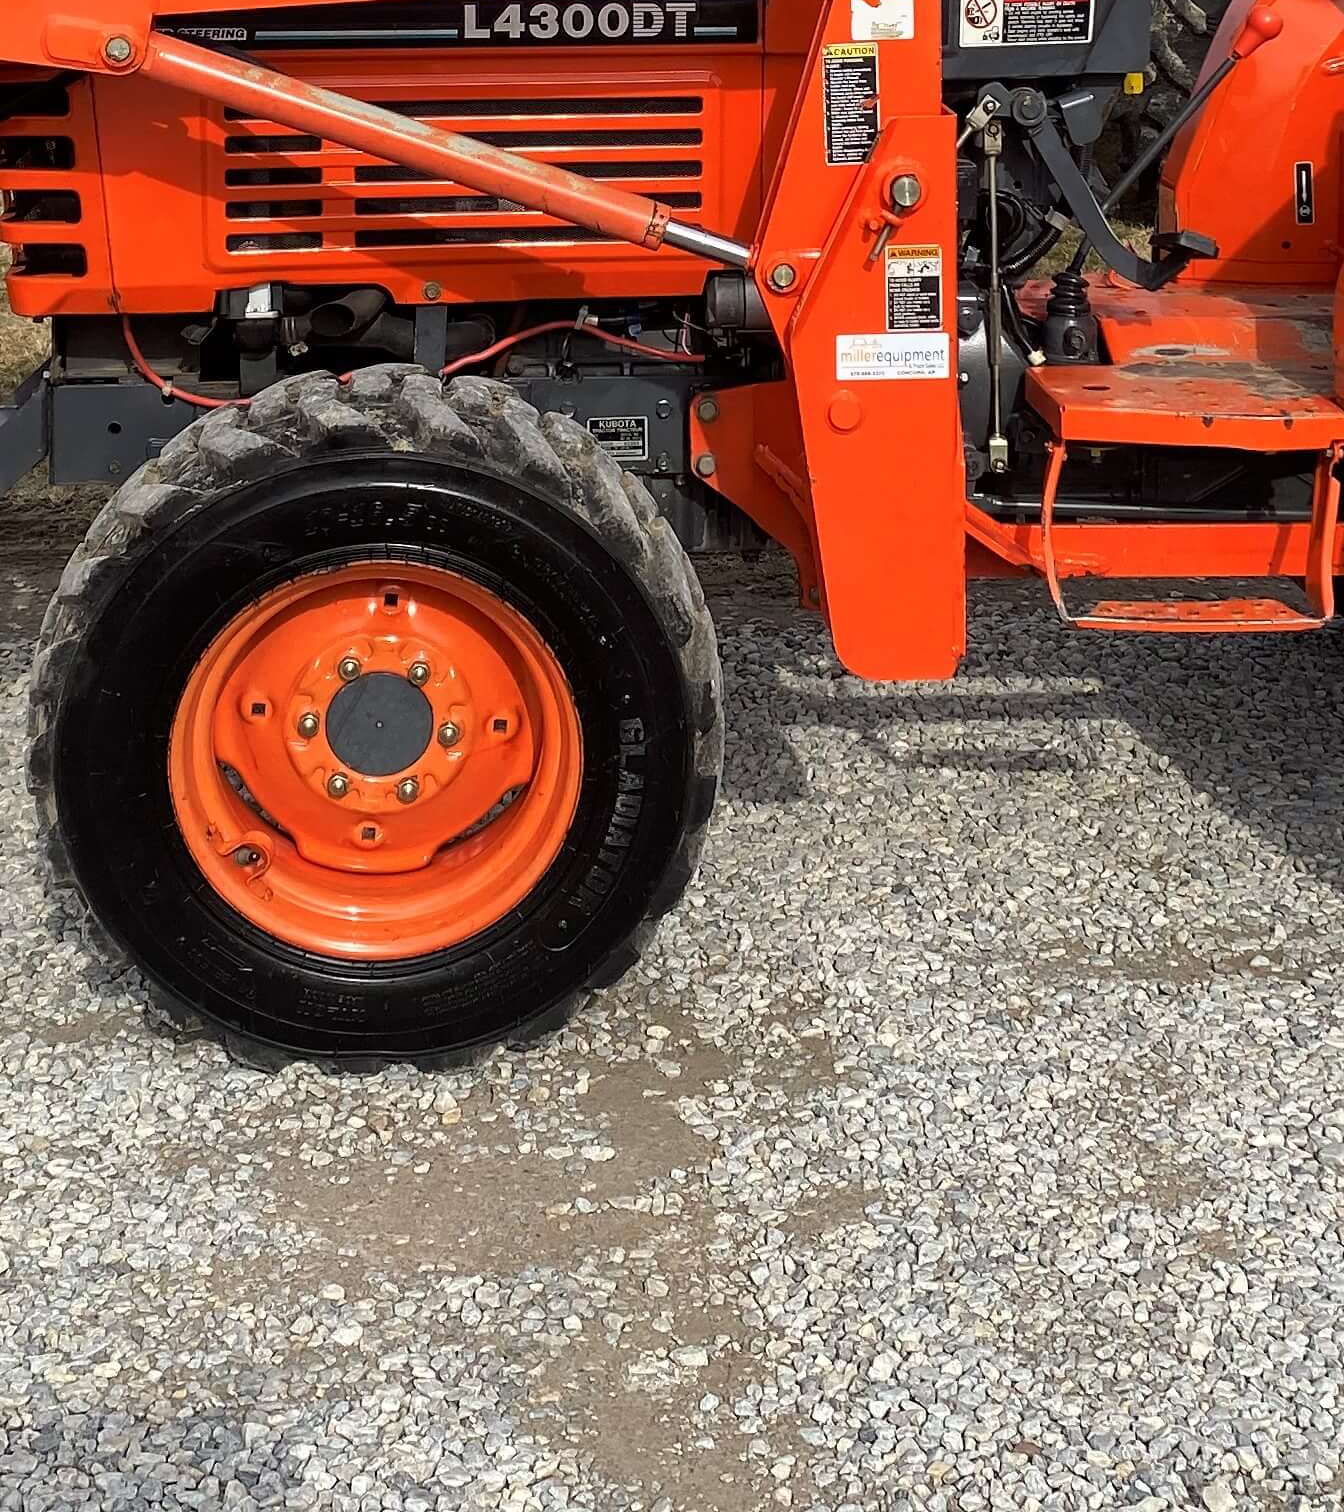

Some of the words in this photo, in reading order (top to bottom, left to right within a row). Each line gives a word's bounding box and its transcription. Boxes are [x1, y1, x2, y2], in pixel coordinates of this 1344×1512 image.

[463, 2, 697, 40] L4300DT
[833, 47, 875, 56] CAUTION
[897, 248, 939, 257] WARNING
[840, 349, 945, 366] millerequipment
[599, 420, 636, 428] KUBOTA
[568, 717, 646, 917] GLADIATOR
